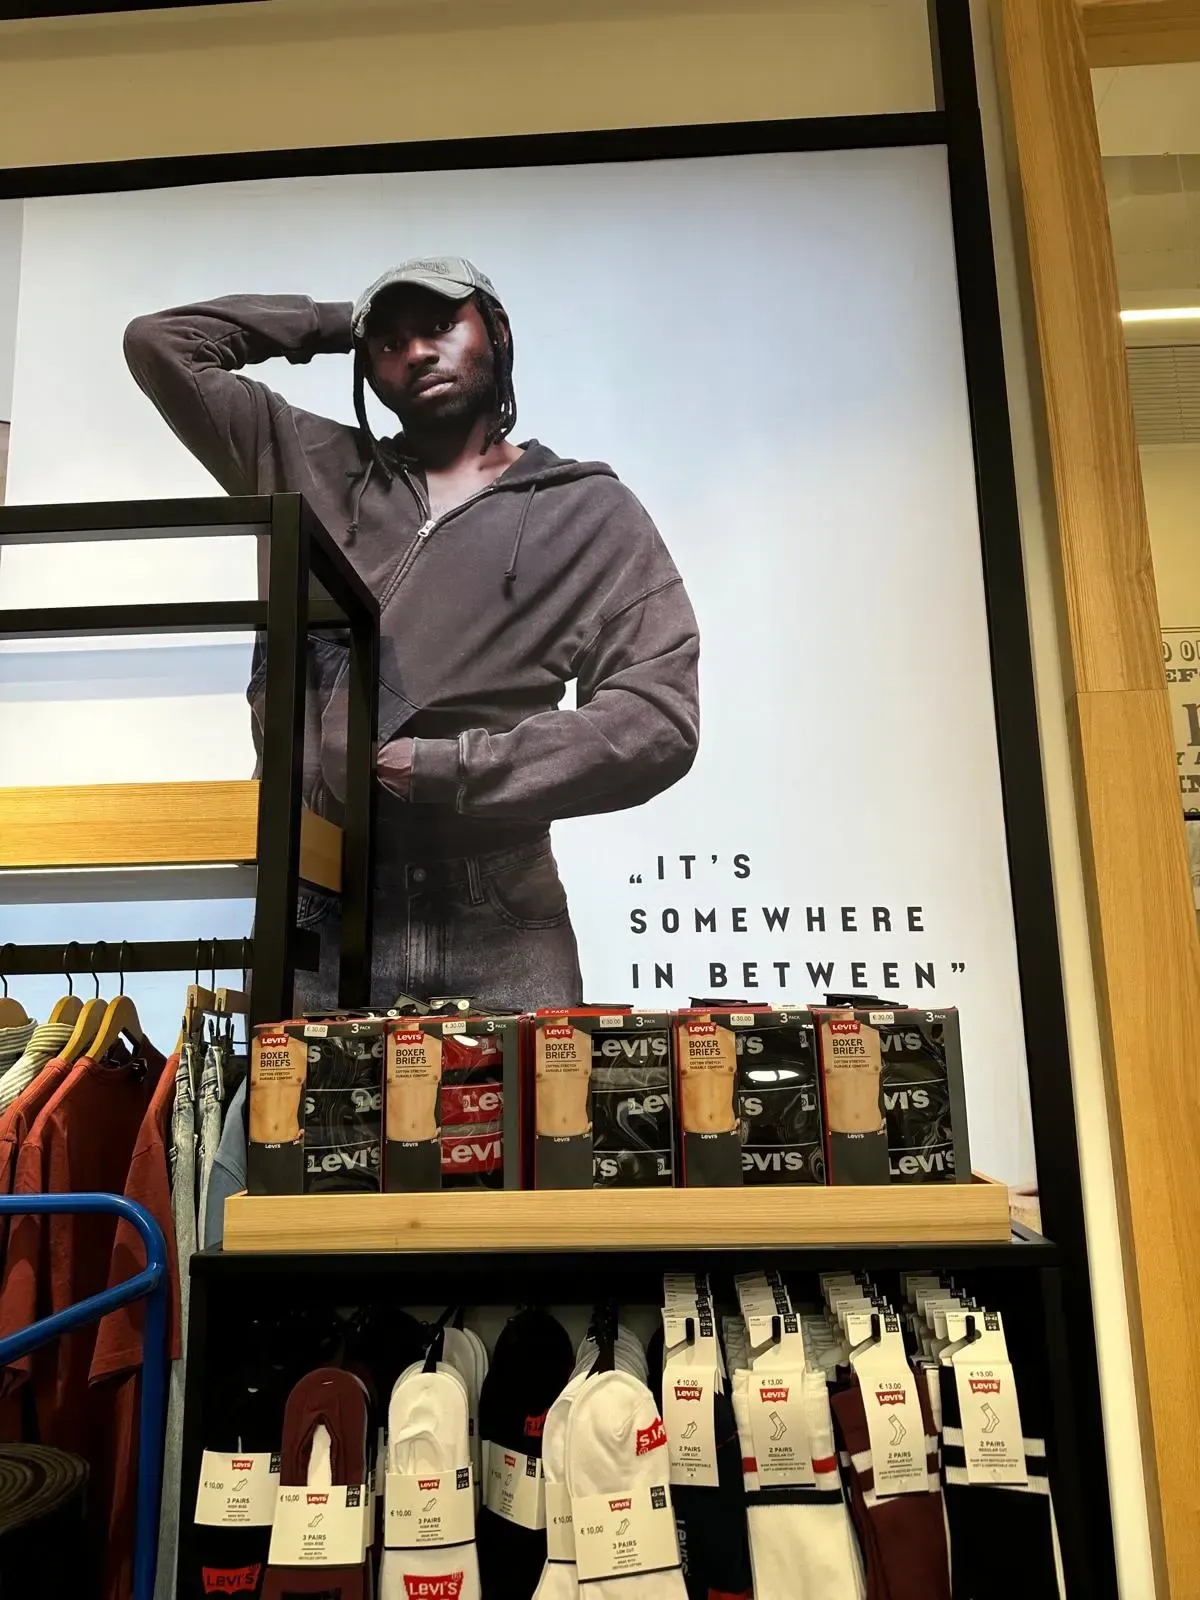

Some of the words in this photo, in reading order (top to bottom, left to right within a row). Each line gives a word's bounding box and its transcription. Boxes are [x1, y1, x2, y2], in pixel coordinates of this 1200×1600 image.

[630, 906, 924, 933] SOMEWHERE
[632, 963, 674, 989] IN
[636, 1017, 644, 1027] 3
[780, 1013, 788, 1023] 3
[926, 1012, 934, 1022] 3
[351, 1023, 360, 1033] 3
[487, 1021, 495, 1032] 3
[689, 1040, 718, 1048] BOXER
[546, 1051, 576, 1059] BRIEFS
[690, 1048, 720, 1056] BRIEFS
[260, 1059, 290, 1067] BRIEFS
[883, 1090, 930, 1110] vi's
[440, 1140, 502, 1164] Levi
[741, 1152, 804, 1171] evi's
[618, 1540, 637, 1548] PAIRS
[409, 1581, 458, 1595] Levi's
